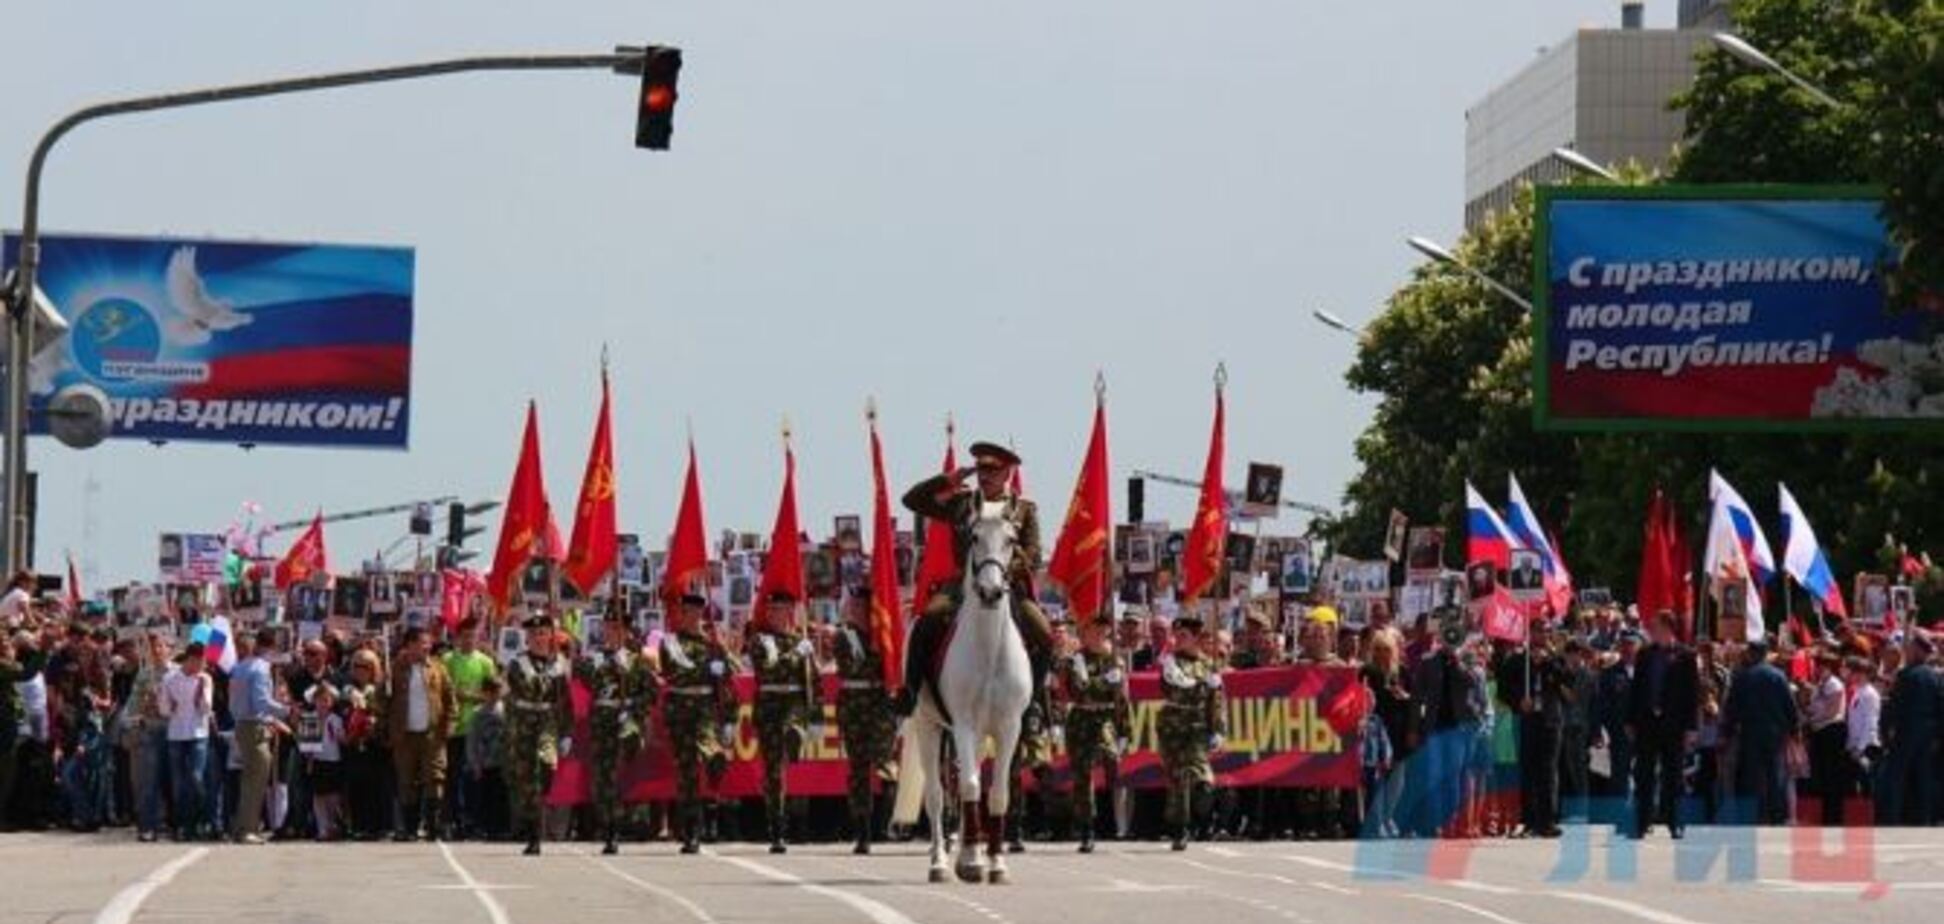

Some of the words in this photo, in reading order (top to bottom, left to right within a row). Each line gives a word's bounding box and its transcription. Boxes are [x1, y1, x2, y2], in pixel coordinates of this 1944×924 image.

[1568, 257, 1596, 287] С
[1601, 254, 1872, 293] праздником,
[1566, 299, 1753, 331] молодая
[1566, 333, 1834, 376] Республика!
